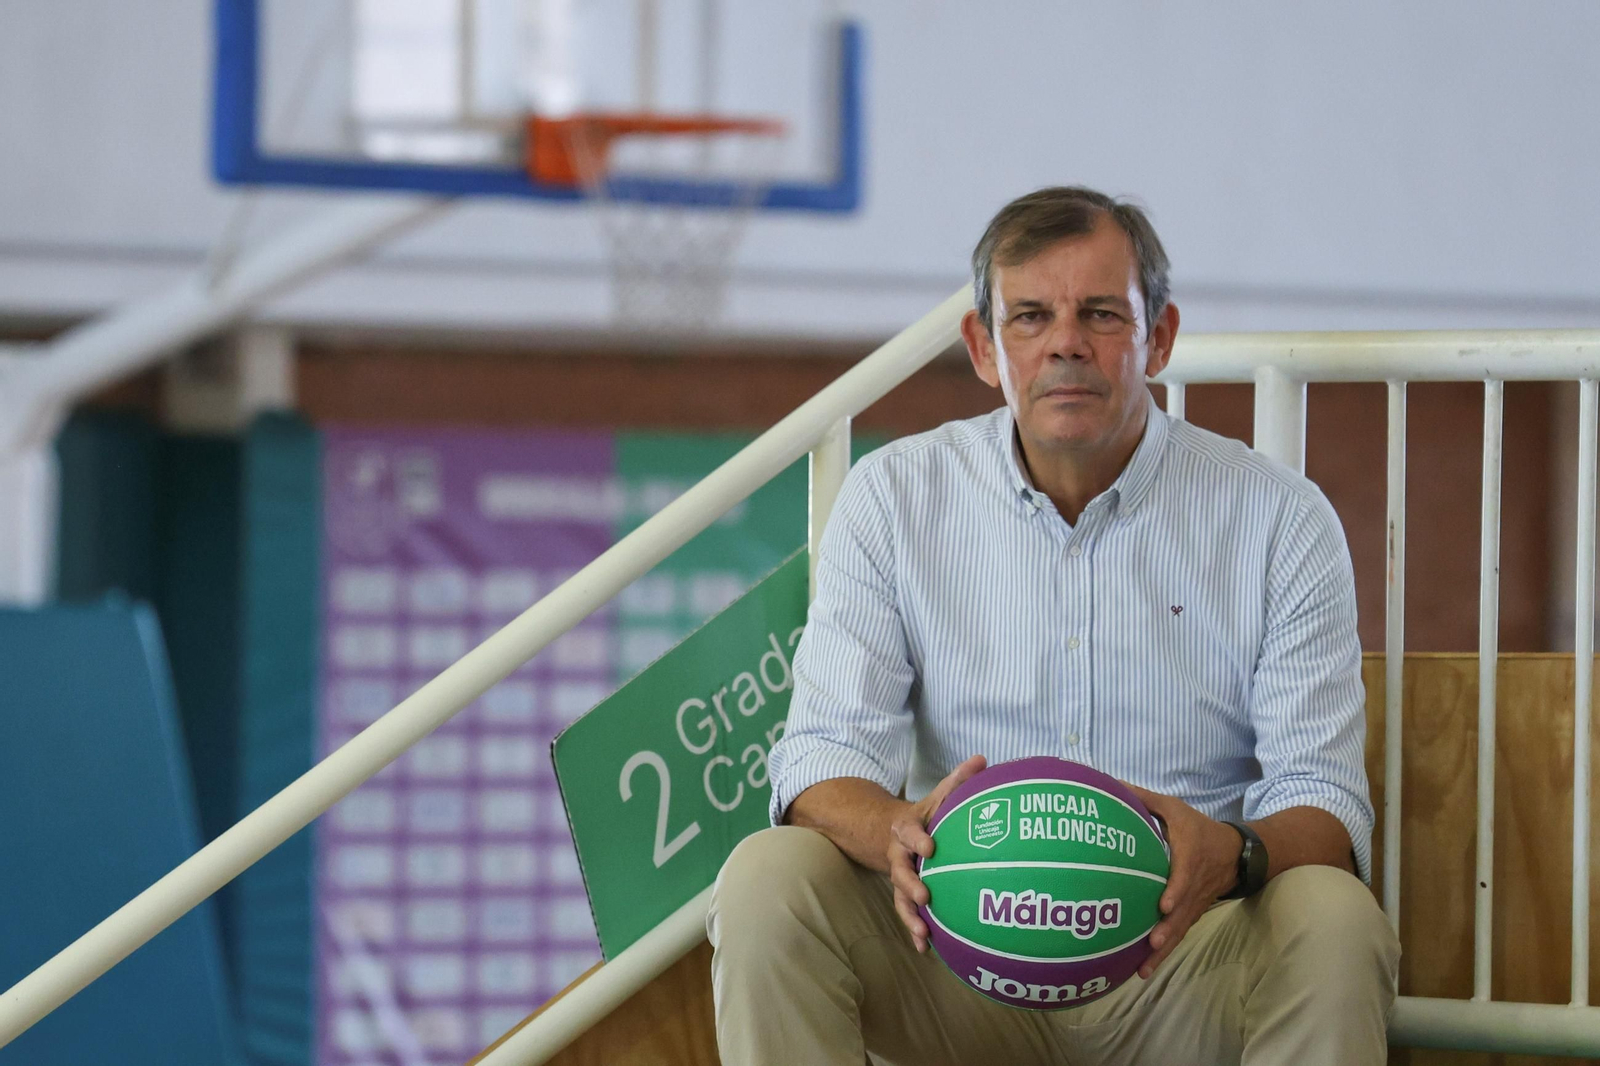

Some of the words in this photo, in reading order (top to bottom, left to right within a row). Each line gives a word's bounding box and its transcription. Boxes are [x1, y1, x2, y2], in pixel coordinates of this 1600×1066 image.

[618, 750, 702, 869] 2
[1019, 793, 1099, 819] UNICAJA
[975, 830, 1004, 841] Baloncesto
[978, 826, 1000, 835] Unicaja
[1019, 817, 1136, 858] BALONCESTO
[979, 889, 1121, 939] Málaga
[968, 966, 1111, 1003] Joma
